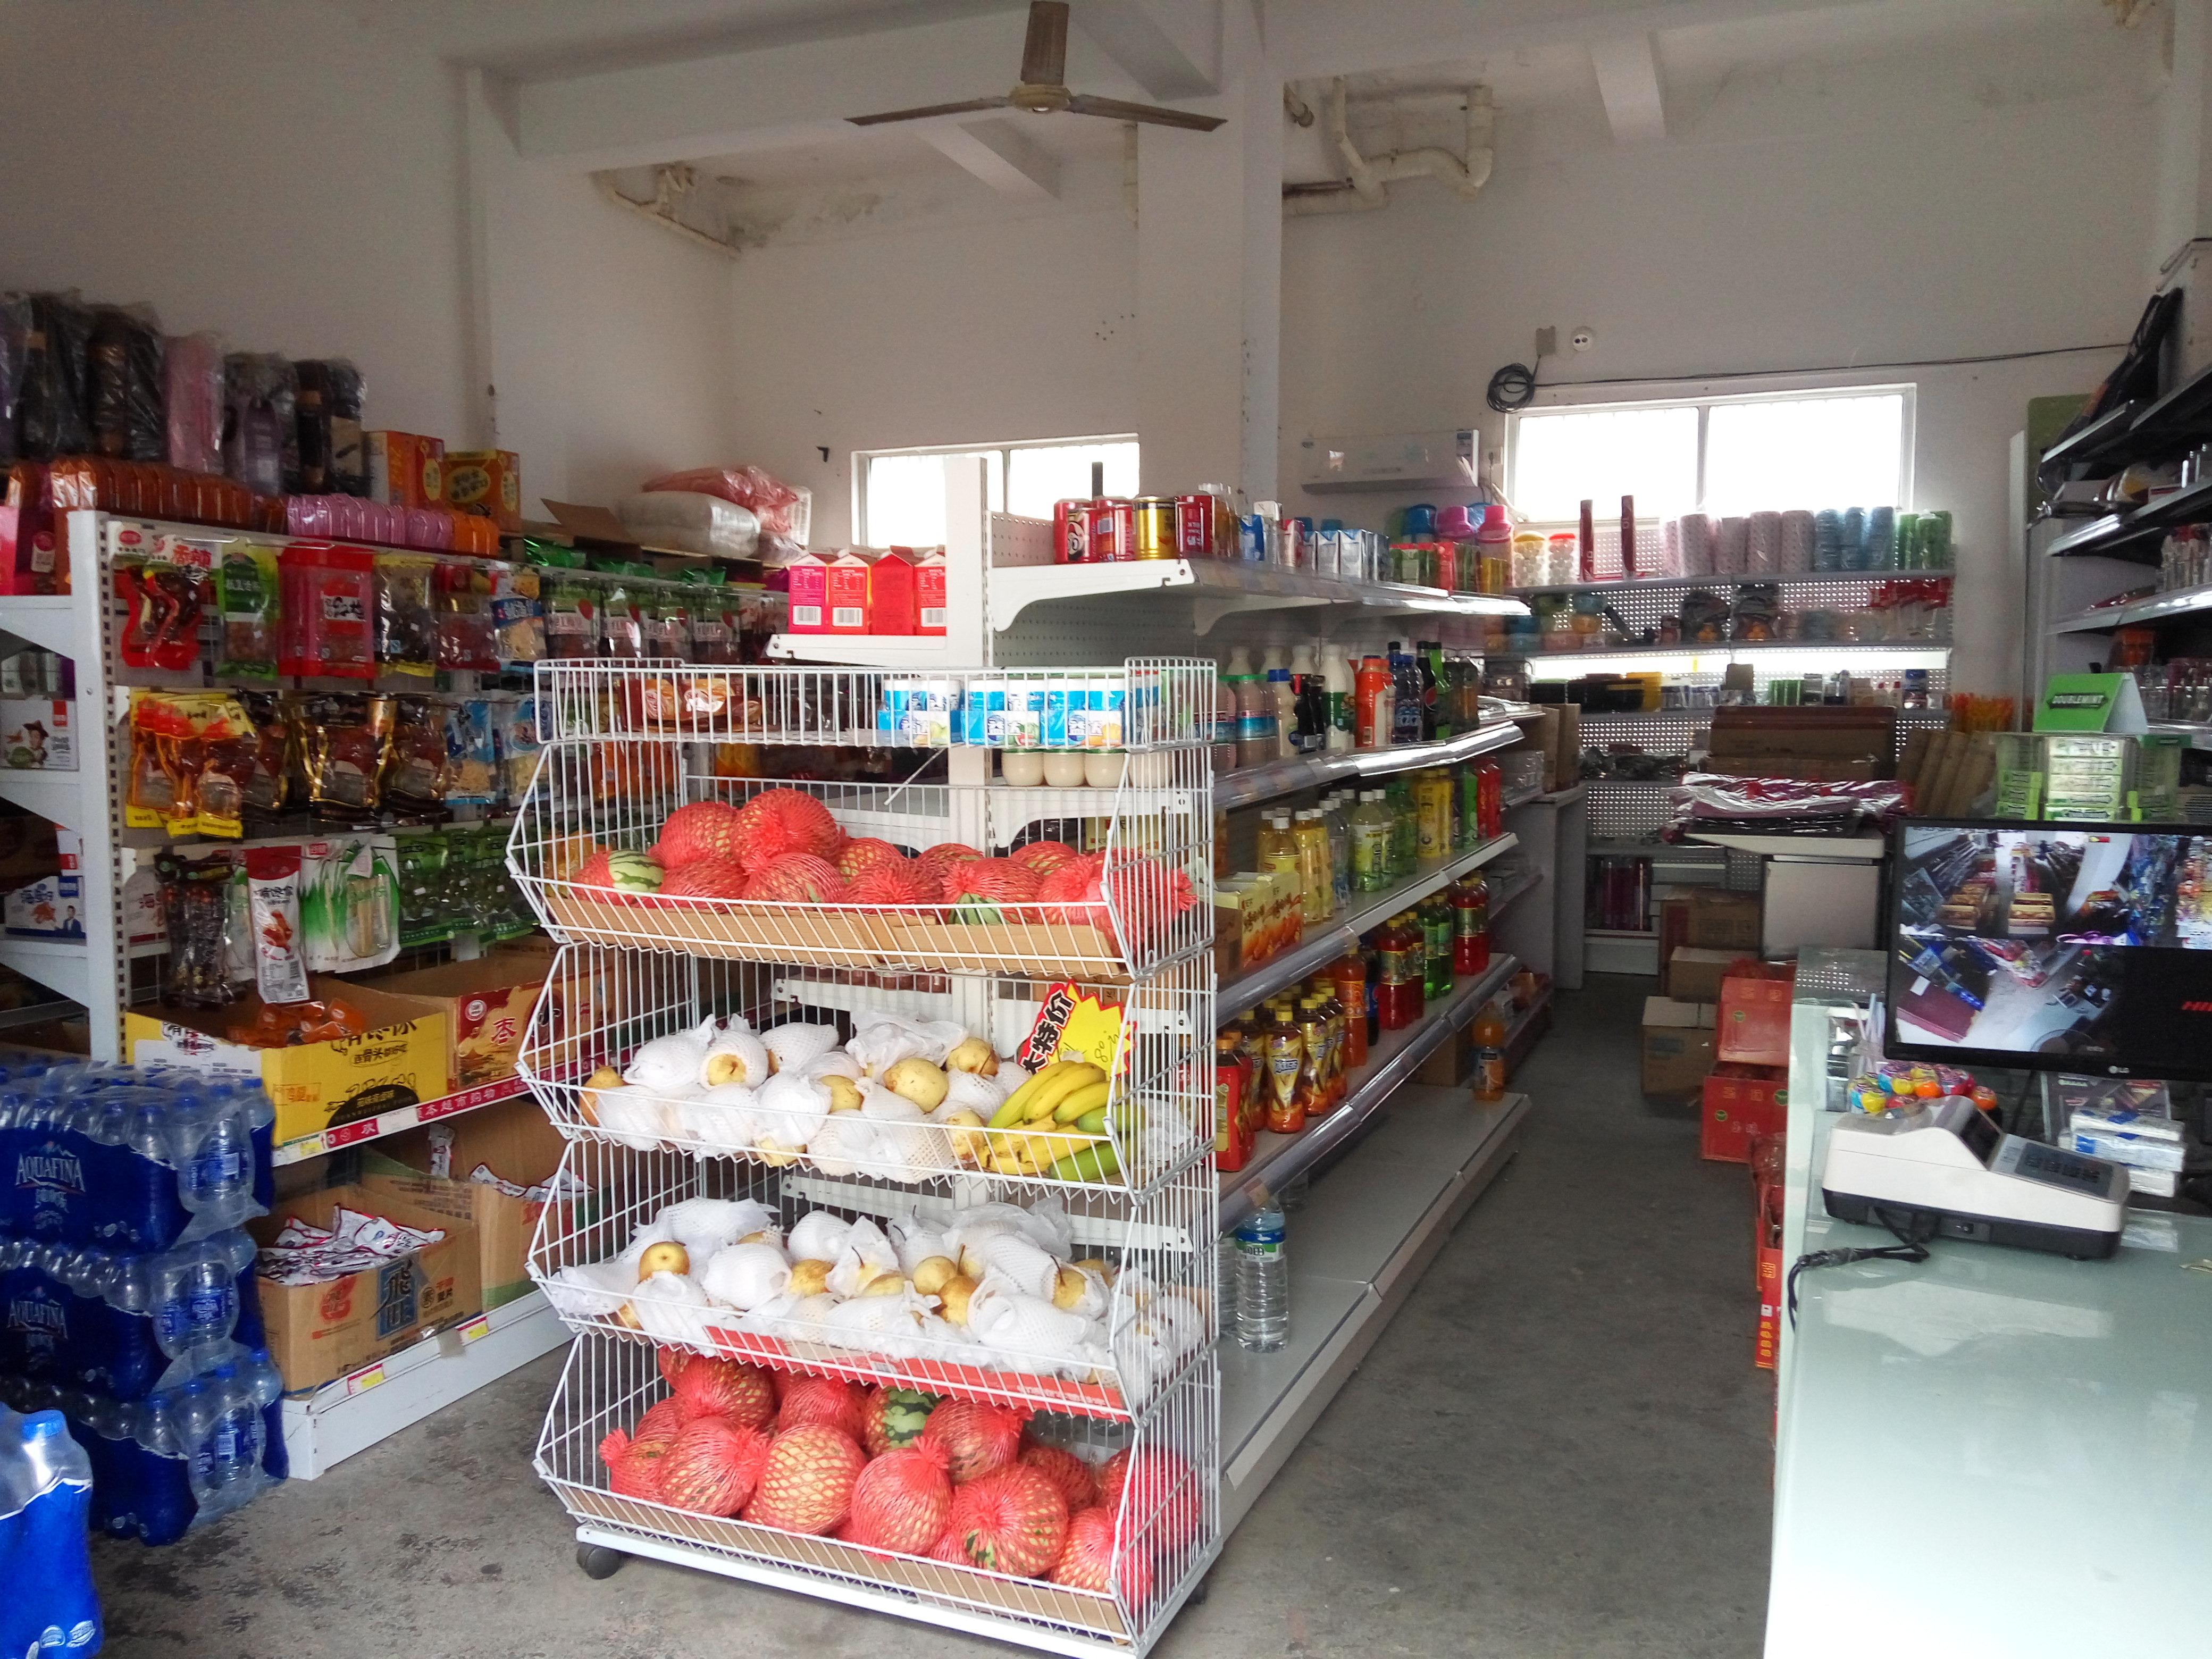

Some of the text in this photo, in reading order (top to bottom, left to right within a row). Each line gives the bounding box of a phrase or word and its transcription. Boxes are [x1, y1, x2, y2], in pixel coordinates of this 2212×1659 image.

[2052, 695, 2105, 705] DOUBLEMINT
[1019, 989, 1076, 1075] 大特价
[15, 1153, 86, 1193] AQUAFINA
